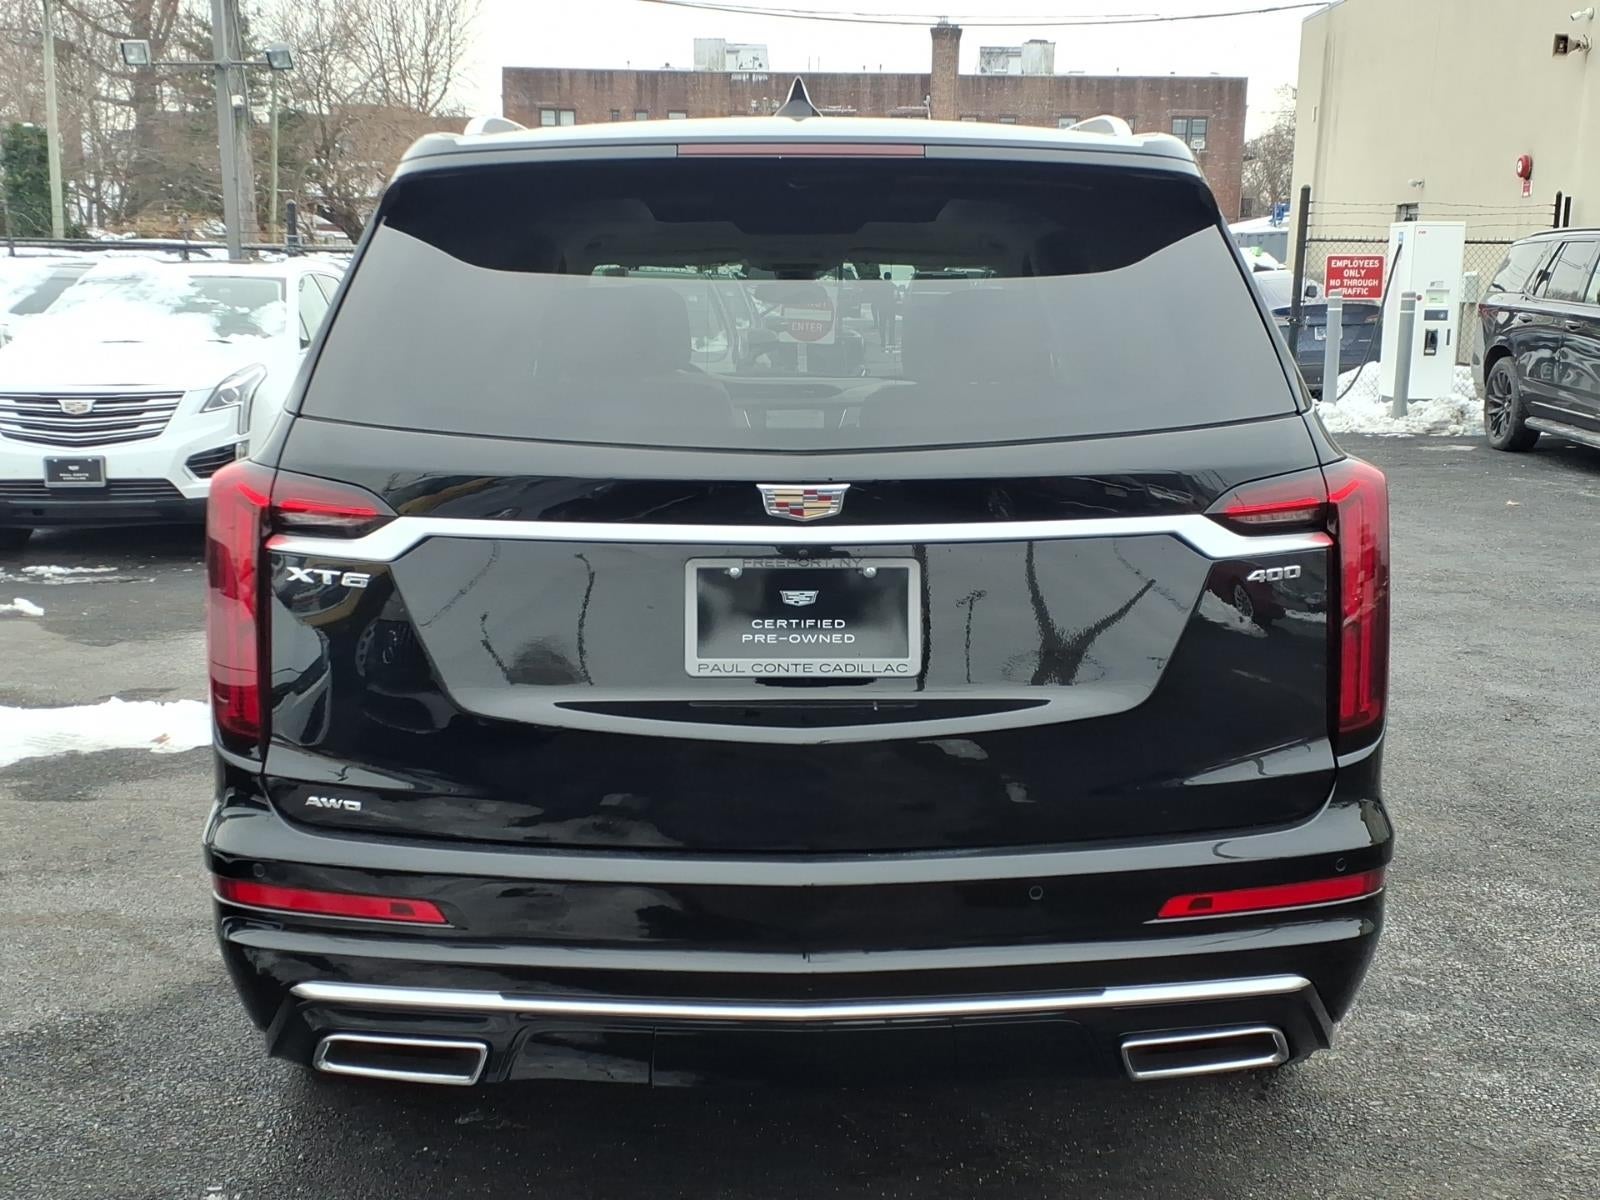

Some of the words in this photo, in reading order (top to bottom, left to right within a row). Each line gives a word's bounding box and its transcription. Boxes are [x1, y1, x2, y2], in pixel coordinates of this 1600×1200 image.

[1331, 259, 1380, 268] EMPLOYEES
[1343, 269, 1366, 278] ONLY
[1330, 279, 1341, 287] NO
[1343, 279, 1379, 287] THROUGH
[1339, 287, 1369, 295] RAFFIC
[286, 566, 371, 588] XT6
[1247, 565, 1301, 583] 400
[751, 619, 846, 629] CERTIFIED
[742, 634, 856, 644] PRE-OWNED
[697, 663, 746, 673] PAUL
[751, 663, 814, 673] CONTE
[819, 663, 909, 673] CADILLAC
[305, 796, 361, 811] AWD
